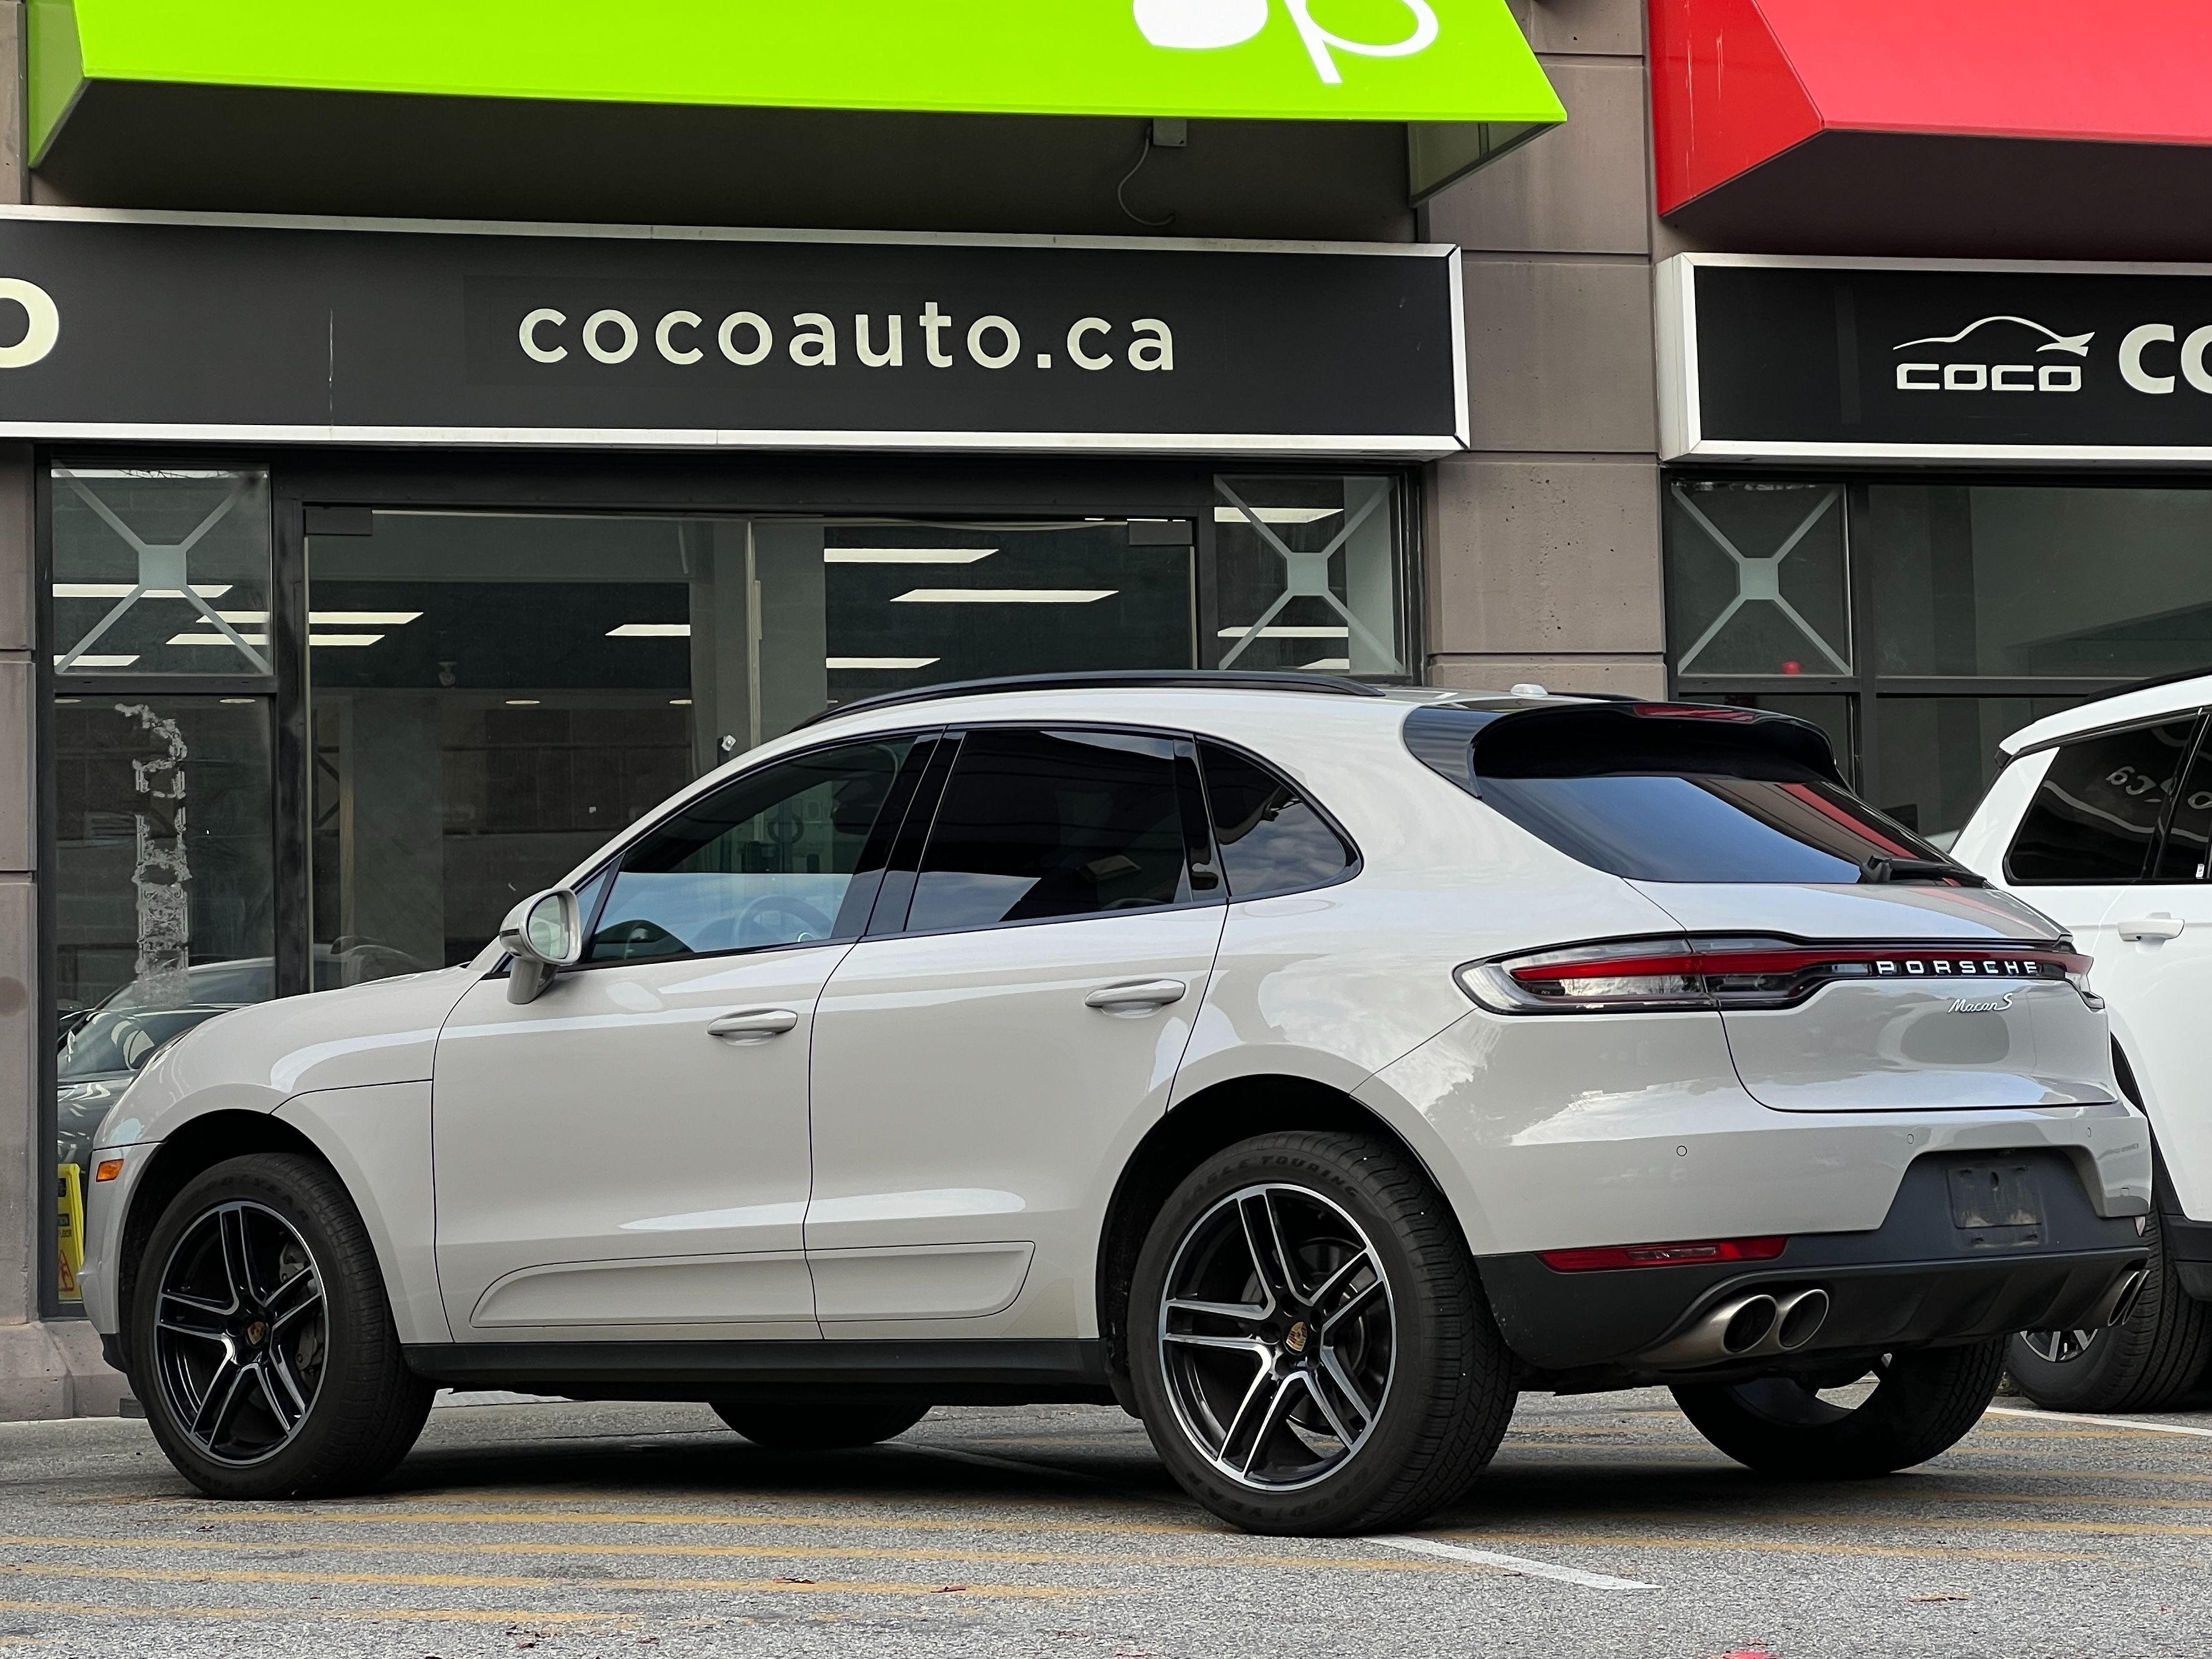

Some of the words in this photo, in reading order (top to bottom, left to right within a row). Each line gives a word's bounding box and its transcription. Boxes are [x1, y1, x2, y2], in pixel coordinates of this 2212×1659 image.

[519, 301, 1174, 371] cocoauto.ca
[1876, 960, 2038, 975] PORSCHE
[1948, 998, 1998, 1013] Macan
[1996, 992, 2013, 1011] S
[1261, 1155, 1359, 1198] TOURING
